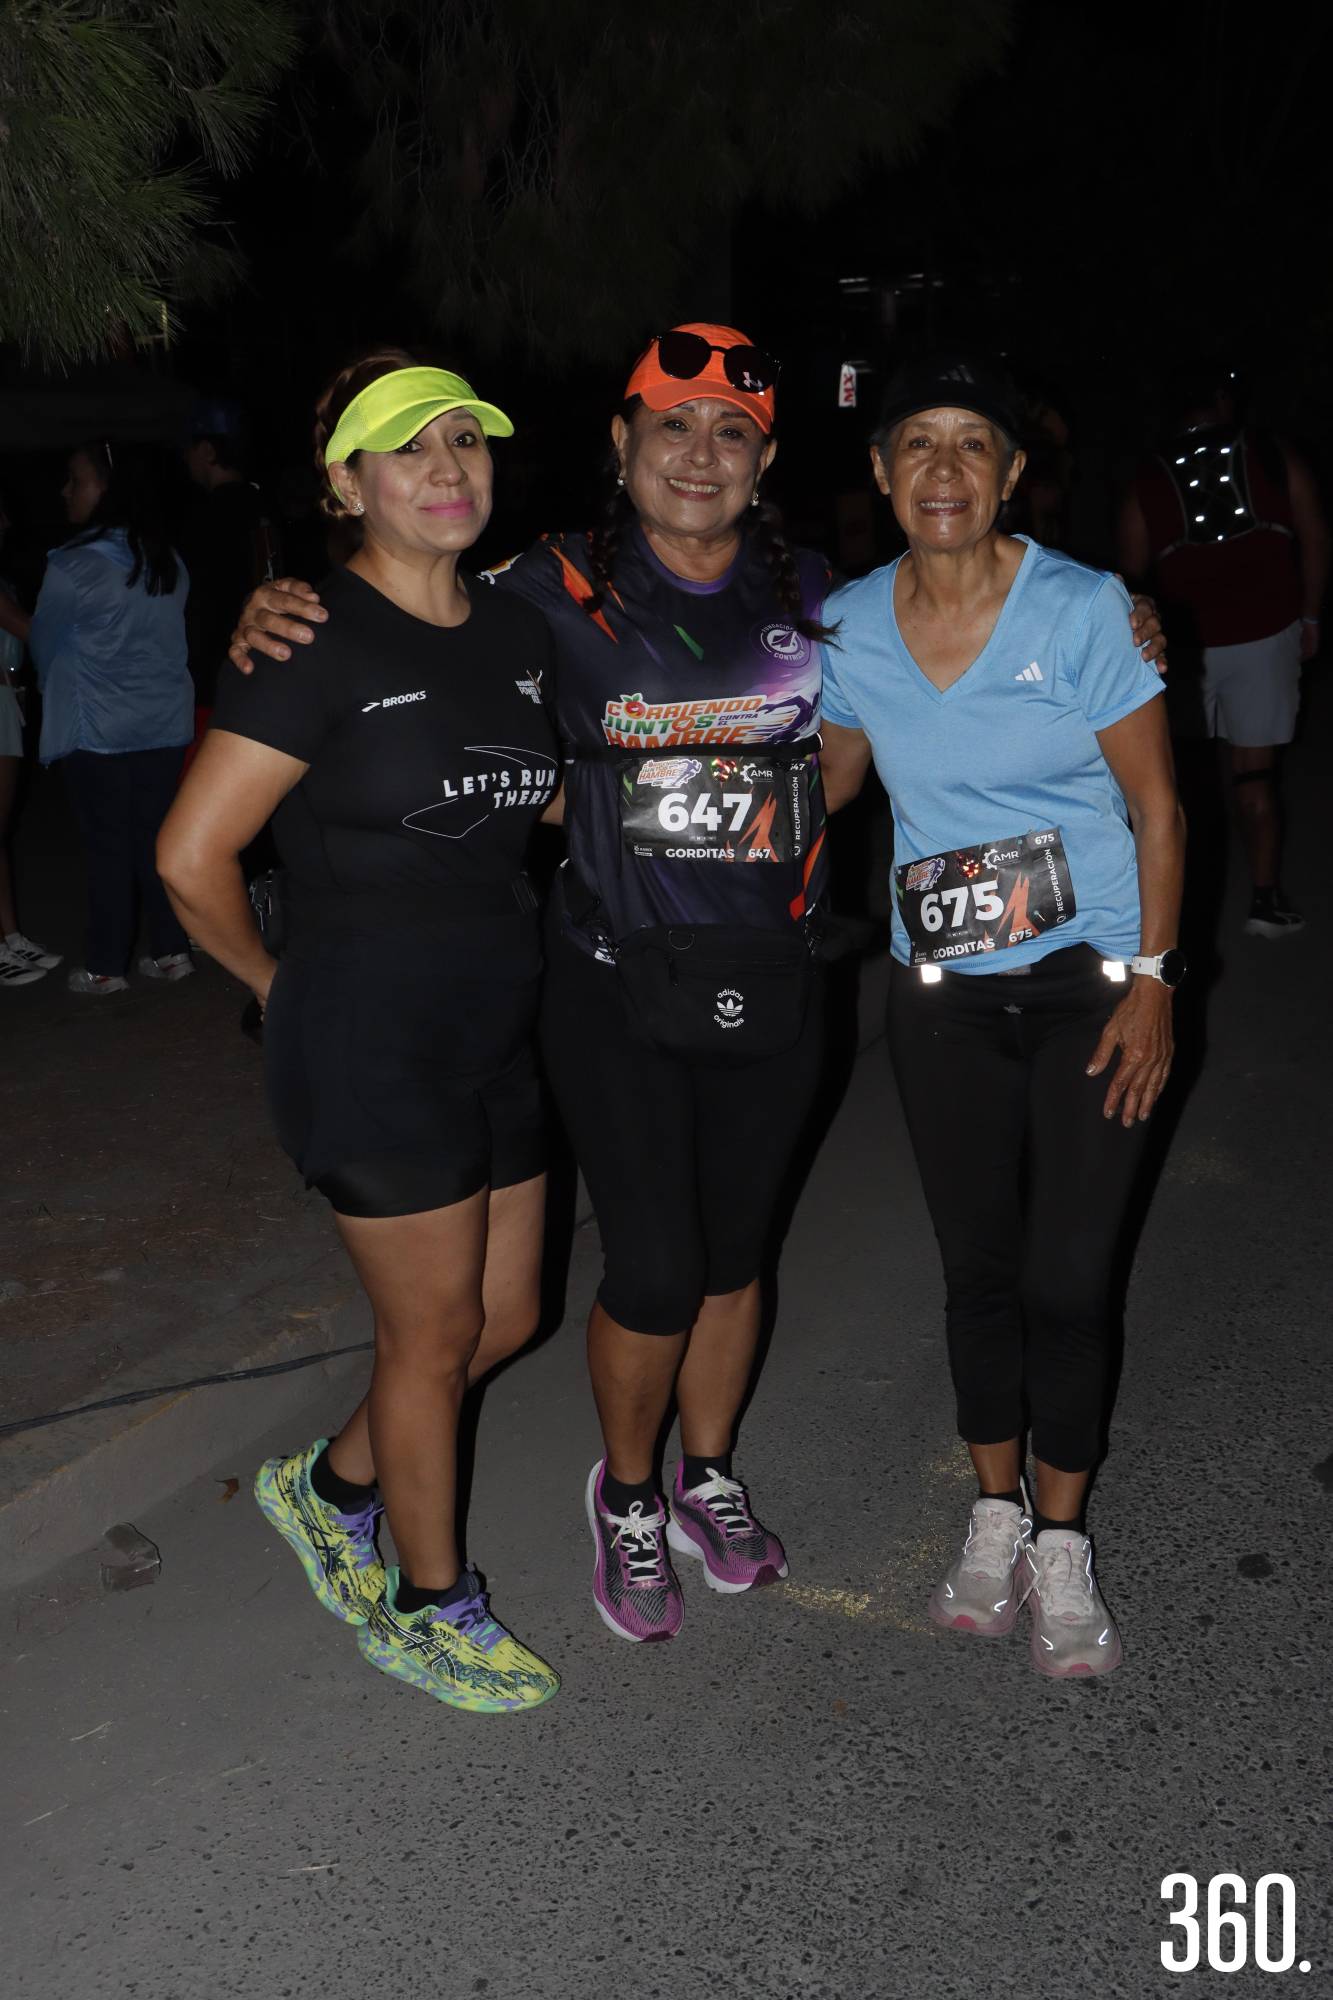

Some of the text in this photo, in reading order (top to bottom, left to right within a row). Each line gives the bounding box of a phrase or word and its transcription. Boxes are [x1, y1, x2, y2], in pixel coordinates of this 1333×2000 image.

[382, 690, 427, 708] BROOKS
[607, 697, 763, 721] CORRIENDO
[718, 713, 759, 721] CONTRA
[604, 713, 717, 734] JUNTOS
[639, 769, 677, 781] HAMBRE
[750, 769, 773, 778] AMR
[443, 769, 556, 797] LET'S RUN
[493, 789, 551, 809] THERE
[657, 792, 753, 832] 647
[792, 776, 801, 840] RECUPERACIÓN
[1035, 833, 1055, 845] 675
[665, 848, 735, 859] GORDITAS
[748, 848, 771, 859] 647
[993, 851, 1020, 863] AMR
[920, 880, 1004, 932] 675
[1008, 928, 1033, 943] 675
[717, 988, 744, 1002] adidas
